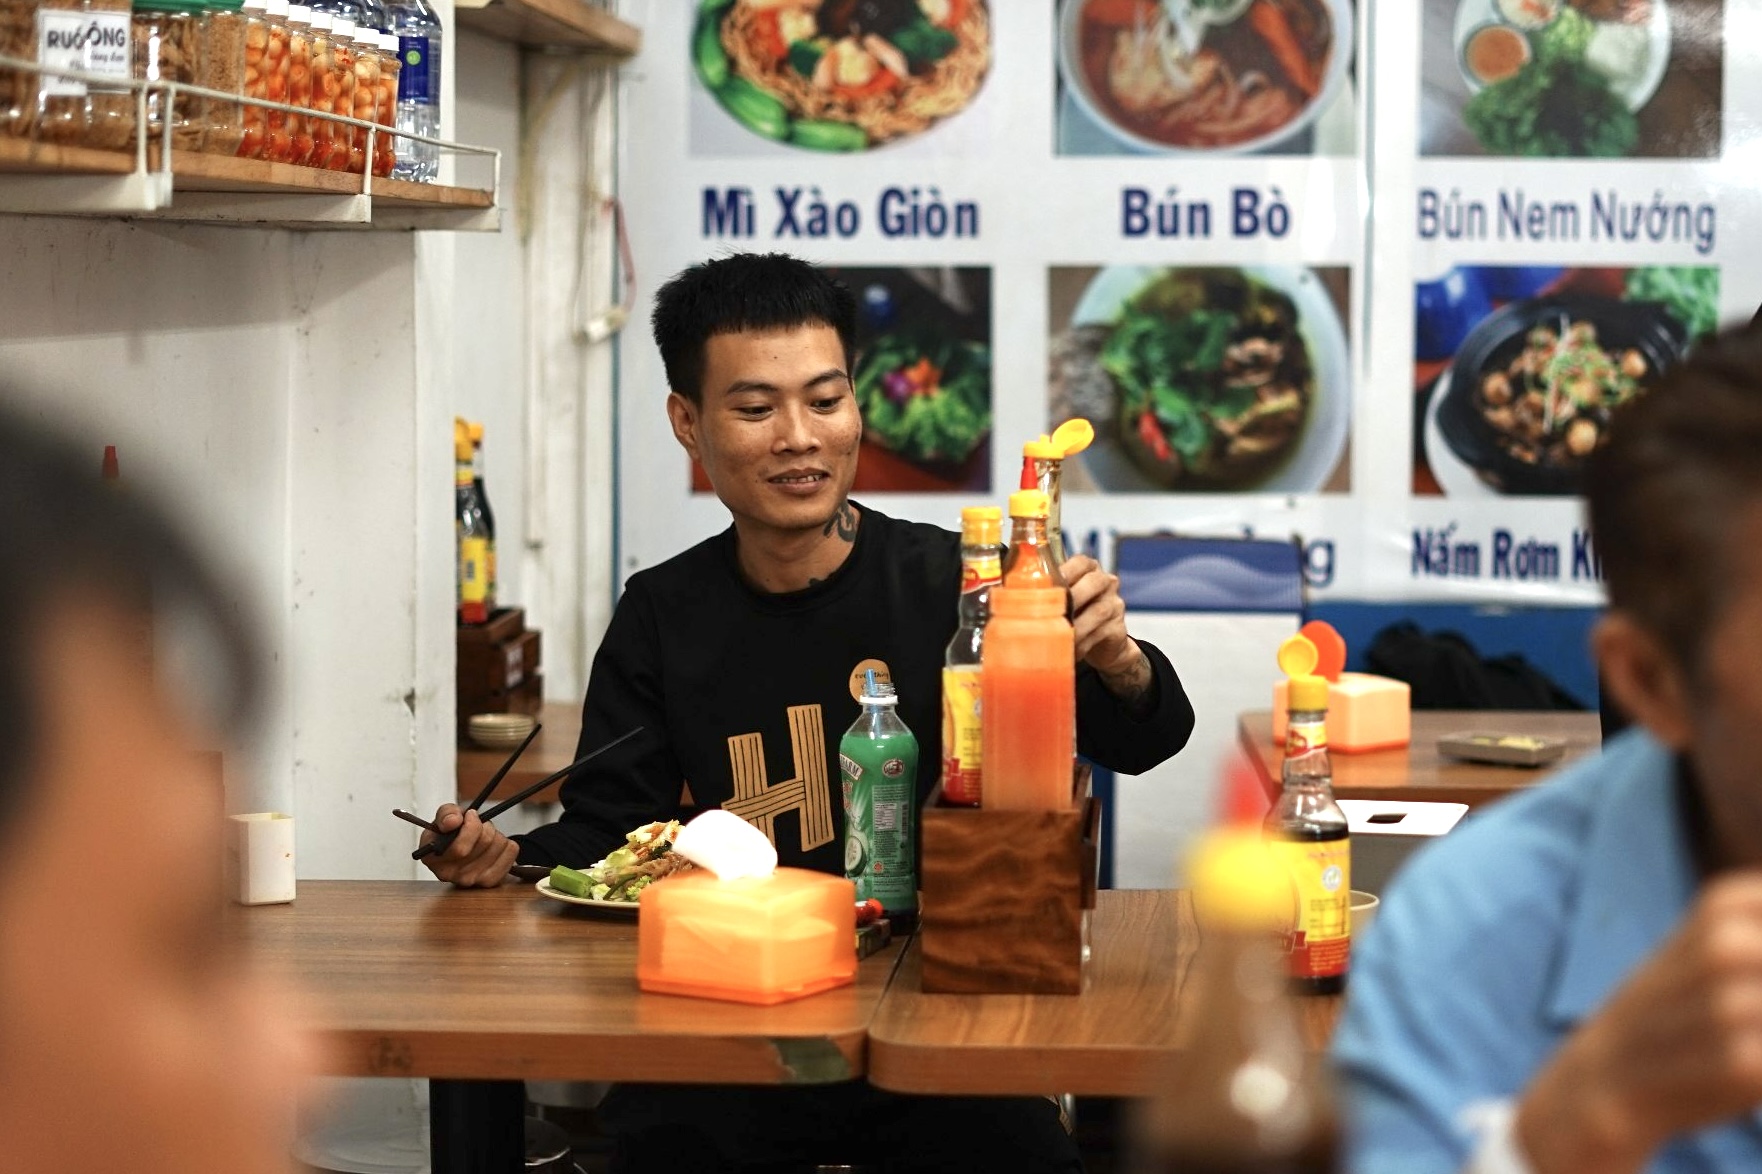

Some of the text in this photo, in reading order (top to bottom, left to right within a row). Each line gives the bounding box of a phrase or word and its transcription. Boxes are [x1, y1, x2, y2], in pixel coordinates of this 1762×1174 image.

[703, 185, 979, 238] Mì Xào Giòn
[1122, 186, 1291, 238] Bún Bò
[1417, 188, 1716, 254] Bún Nem Nướng
[1492, 527, 1560, 580] Rơm
